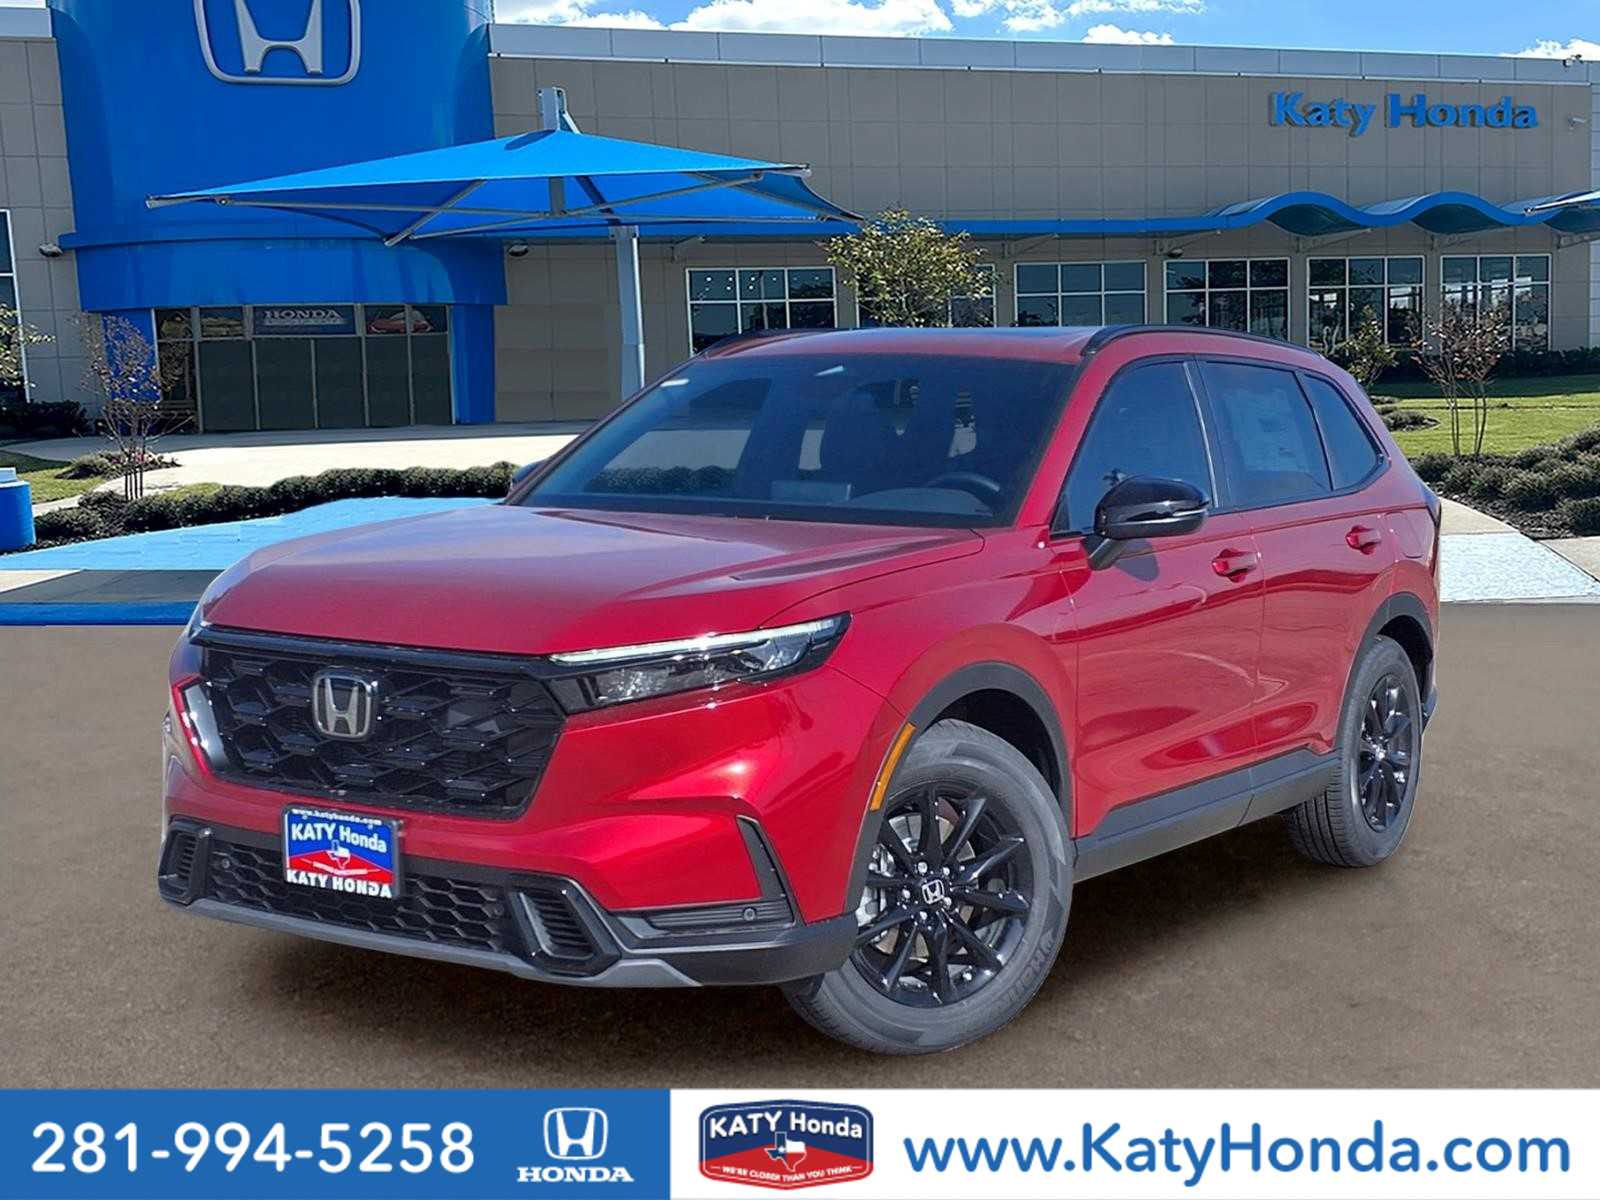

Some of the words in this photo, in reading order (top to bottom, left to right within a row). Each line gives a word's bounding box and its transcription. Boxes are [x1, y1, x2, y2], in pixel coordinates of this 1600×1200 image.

[1269, 91, 1376, 137] Katy
[1385, 93, 1539, 129] Honda
[264, 309, 344, 320] HONDA
[291, 822, 337, 841] KATY
[339, 825, 387, 853] Honda
[286, 869, 329, 888] KATY
[332, 876, 393, 899] HONDA
